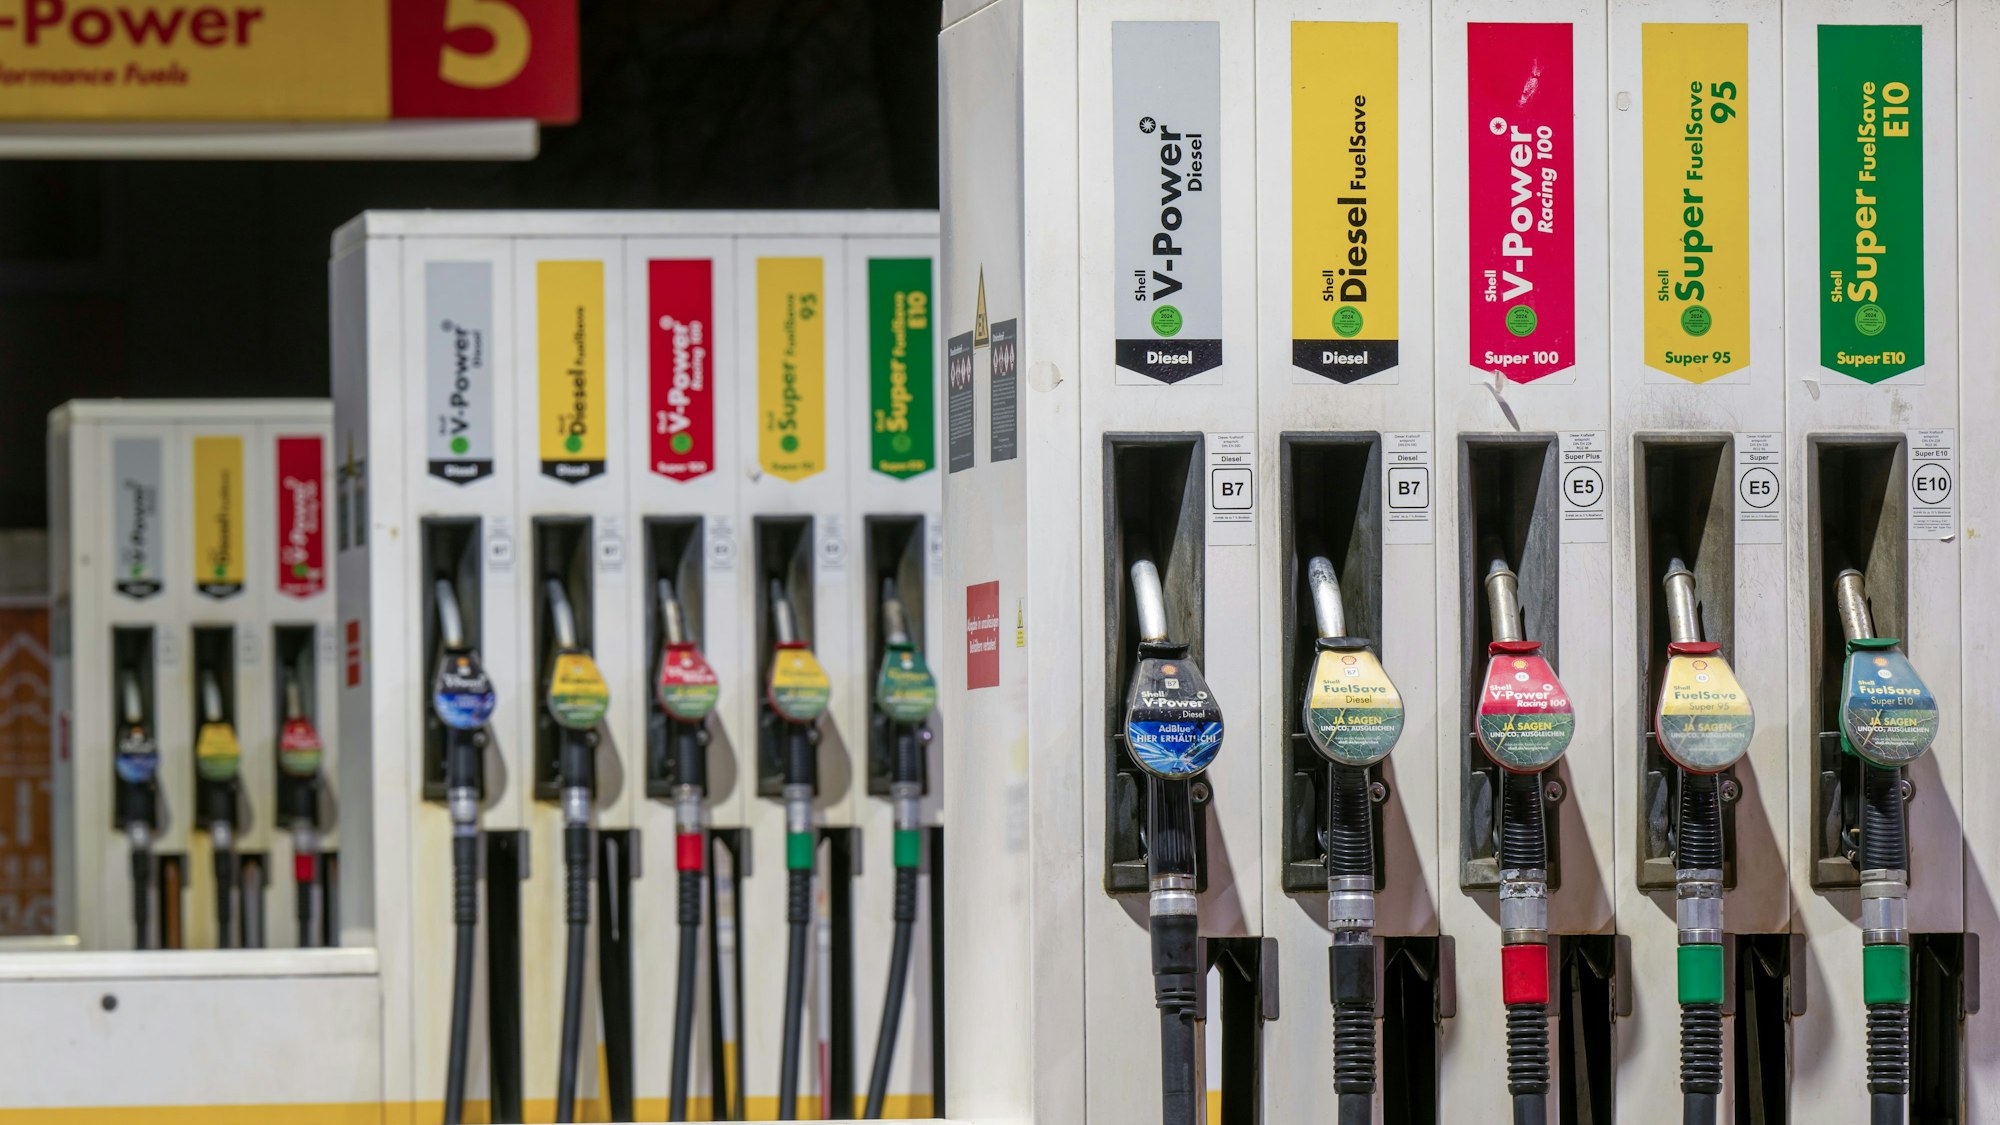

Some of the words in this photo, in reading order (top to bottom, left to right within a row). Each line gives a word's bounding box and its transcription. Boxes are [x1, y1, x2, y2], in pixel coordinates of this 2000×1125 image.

[438, 0, 532, 88] 5
[1710, 81, 1737, 124] 95
[1882, 82, 1910, 137] E10
[1684, 81, 1703, 180] FuelSave
[1857, 82, 1876, 181] FuelSave
[1349, 95, 1366, 190] FuelSave
[1536, 125, 1553, 159] 100
[1186, 134, 1202, 191] Diesel
[1536, 167, 1557, 233] Racing
[1153, 125, 1182, 301] V-Power
[1502, 125, 1533, 302] V-Power
[1337, 198, 1367, 302] Diesel
[1674, 188, 1713, 301] Super
[1847, 189, 1886, 302] Super
[1135, 270, 1146, 301] Shell
[1323, 270, 1334, 301] Shell
[1484, 270, 1496, 302] Shell
[1658, 270, 1669, 302] Shell
[1831, 271, 1843, 303] Shell
[1147, 351, 1193, 364] Diesel
[1323, 351, 1368, 364] Diesel
[1485, 351, 1529, 367] Super
[1533, 351, 1559, 364] 100
[1665, 351, 1708, 366] Super
[1712, 351, 1731, 364] 95
[1837, 351, 1880, 367] Super
[1882, 352, 1906, 364] E10
[449, 325, 470, 435] V-Power
[667, 320, 691, 434] V-Power
[567, 369, 587, 436] Diesel
[778, 361, 801, 431] Super
[886, 358, 913, 433] Super
[1222, 482, 1244, 496] B7
[1399, 481, 1420, 495] B7
[1573, 480, 1594, 494] E5
[1750, 481, 1770, 495] E5
[1917, 477, 1947, 491] E10
[1324, 684, 1386, 693] FuelSave
[1491, 691, 1550, 700] V-Power
[1675, 691, 1737, 700] FuelSave
[1860, 686, 1921, 695] FuelSave
[1143, 698, 1203, 707] V-Power
[1345, 695, 1372, 704] Diesel
[1517, 700, 1547, 709] Racing
[1550, 699, 1566, 707] 100
[1689, 703, 1714, 712] Super
[1871, 697, 1895, 706] Super
[1897, 697, 1914, 706] E10
[1182, 710, 1205, 718] Diesel
[1333, 716, 1345, 725] JA
[1347, 716, 1382, 725] SAGEN
[1869, 717, 1881, 726] JA
[1884, 718, 1917, 726] SAGEN
[1502, 722, 1514, 731] JA
[1517, 722, 1552, 731] SAGEN
[1683, 723, 1694, 732] JA
[1698, 723, 1733, 732] SAGEN
[1136, 735, 1157, 743] HIER
